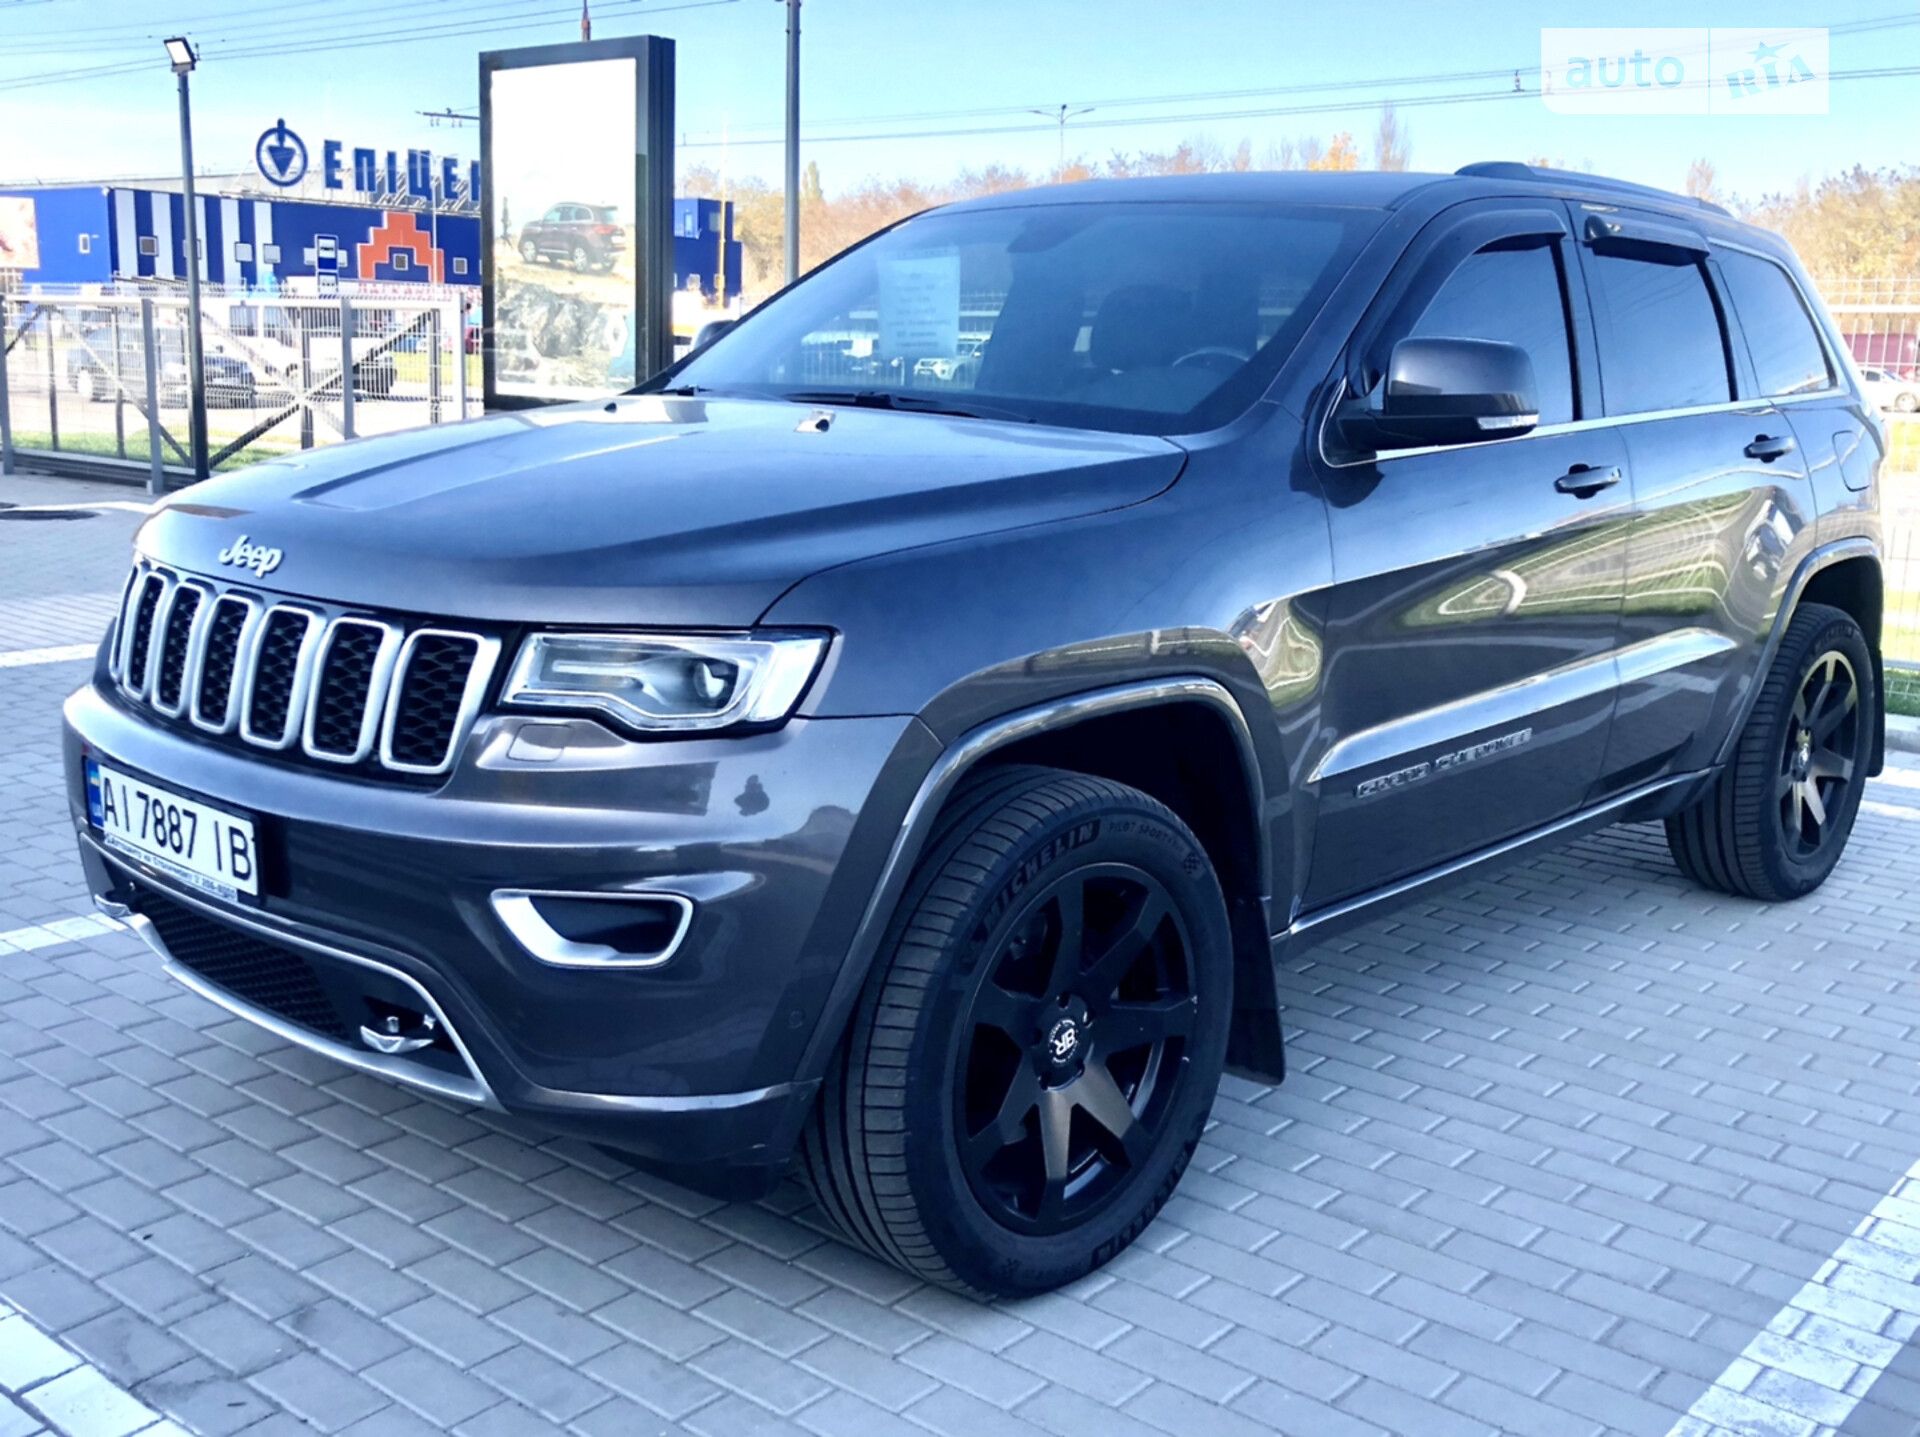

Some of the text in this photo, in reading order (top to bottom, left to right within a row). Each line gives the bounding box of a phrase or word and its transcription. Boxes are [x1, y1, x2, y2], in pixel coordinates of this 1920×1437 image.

[219, 534, 283, 578] Jeep
[103, 777, 252, 881] AI 7887 IB
[983, 821, 1095, 933] MICHELIN
